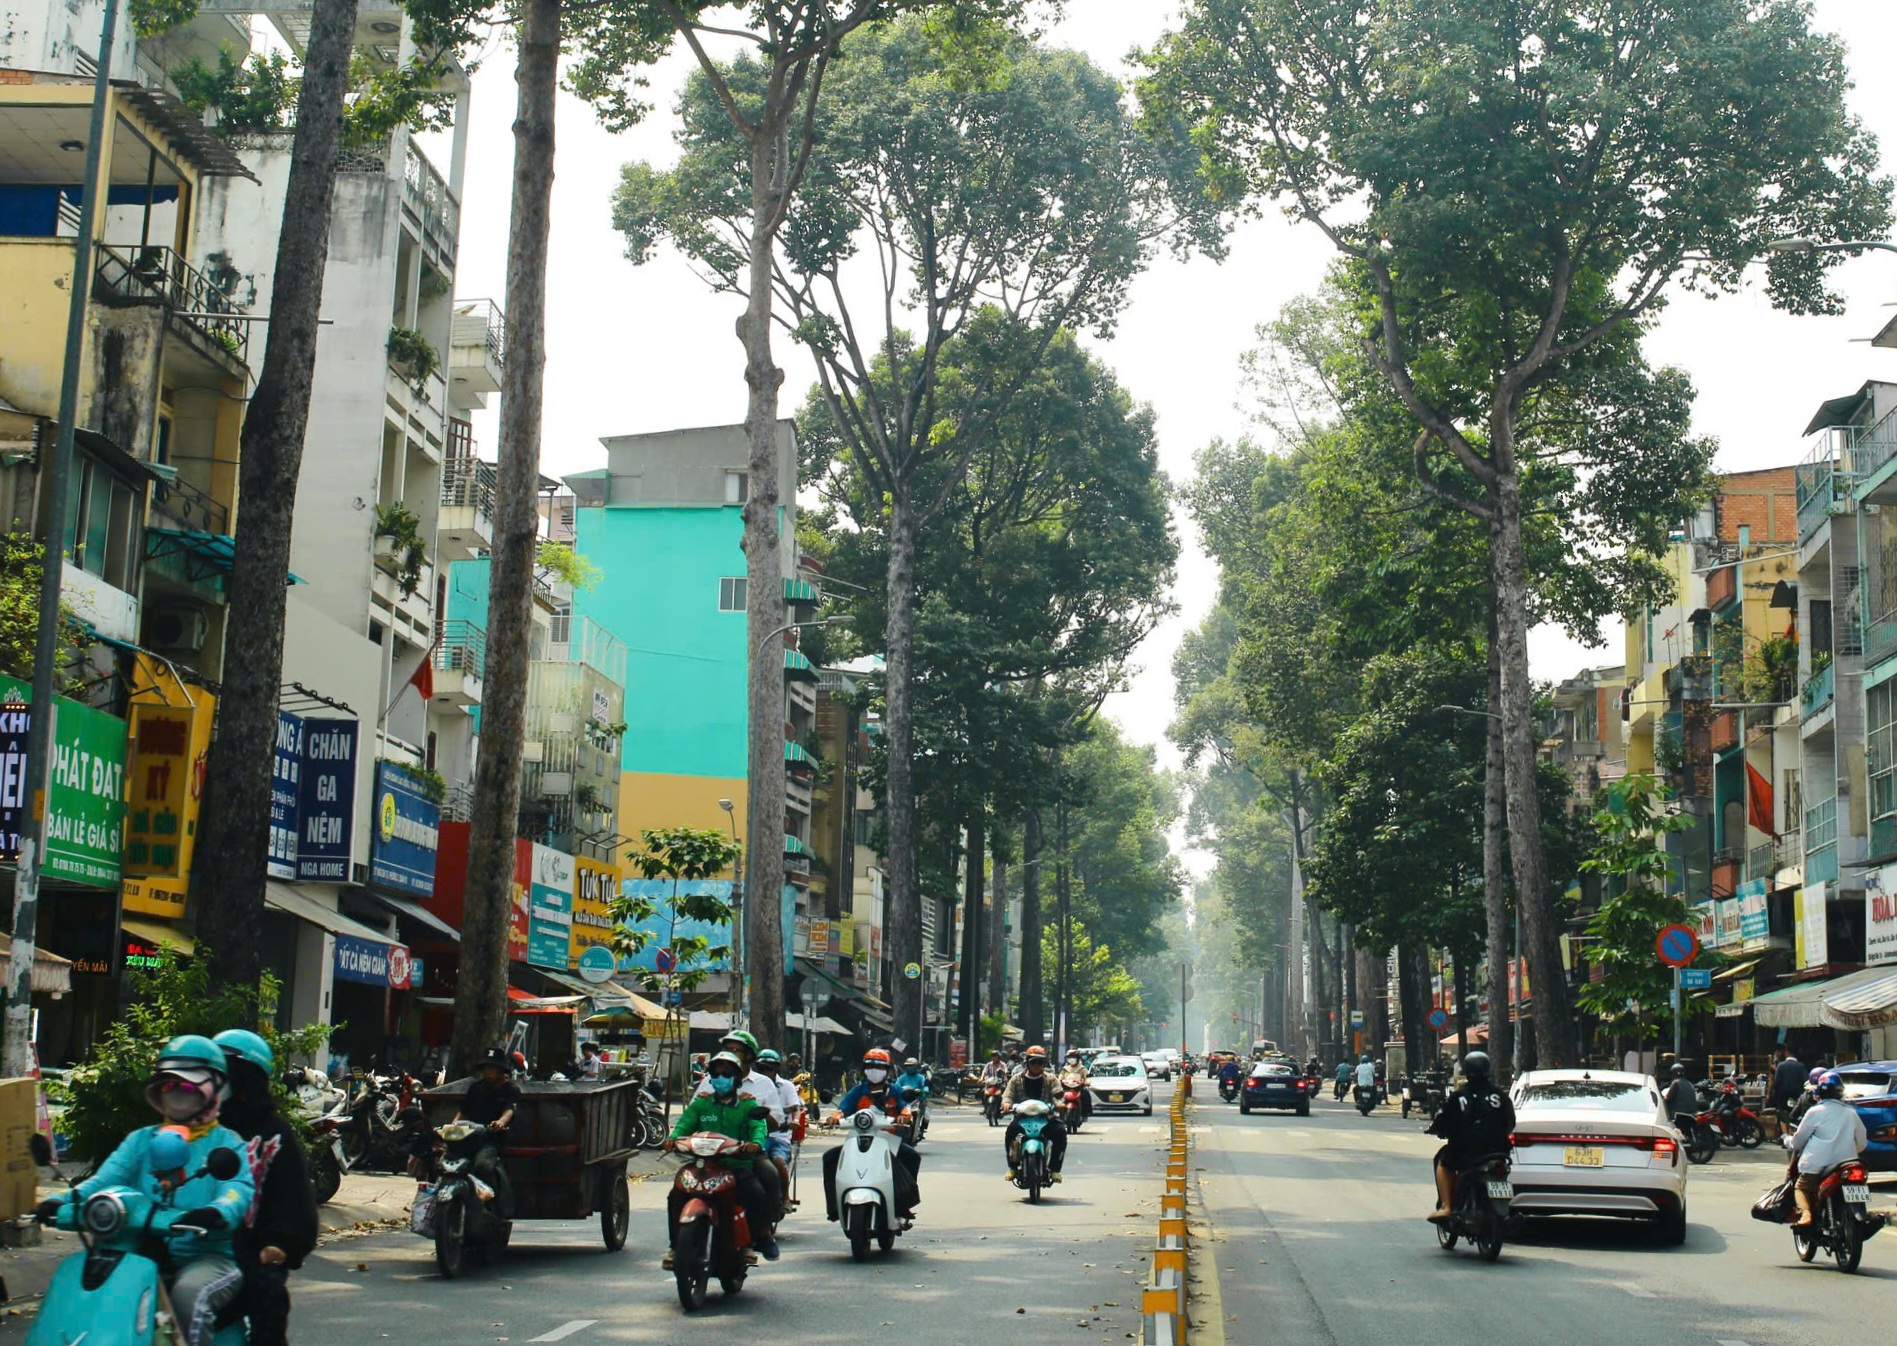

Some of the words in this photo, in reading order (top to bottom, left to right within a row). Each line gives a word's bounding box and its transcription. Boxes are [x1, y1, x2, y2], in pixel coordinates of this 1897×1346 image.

[309, 728, 351, 760] CHĂN
[92, 756, 122, 811] ĐẠT
[317, 775, 337, 802] GA
[47, 808, 71, 842] BÁN
[73, 811, 85, 845] LẺ
[87, 820, 107, 851] GIÁ
[307, 811, 342, 850] NỆM
[301, 862, 318, 876] NGA
[320, 863, 344, 877] HOME
[580, 868, 598, 900] Tuk
[700, 1114, 718, 1122] Grab
[1575, 1148, 1593, 1157] 63H
